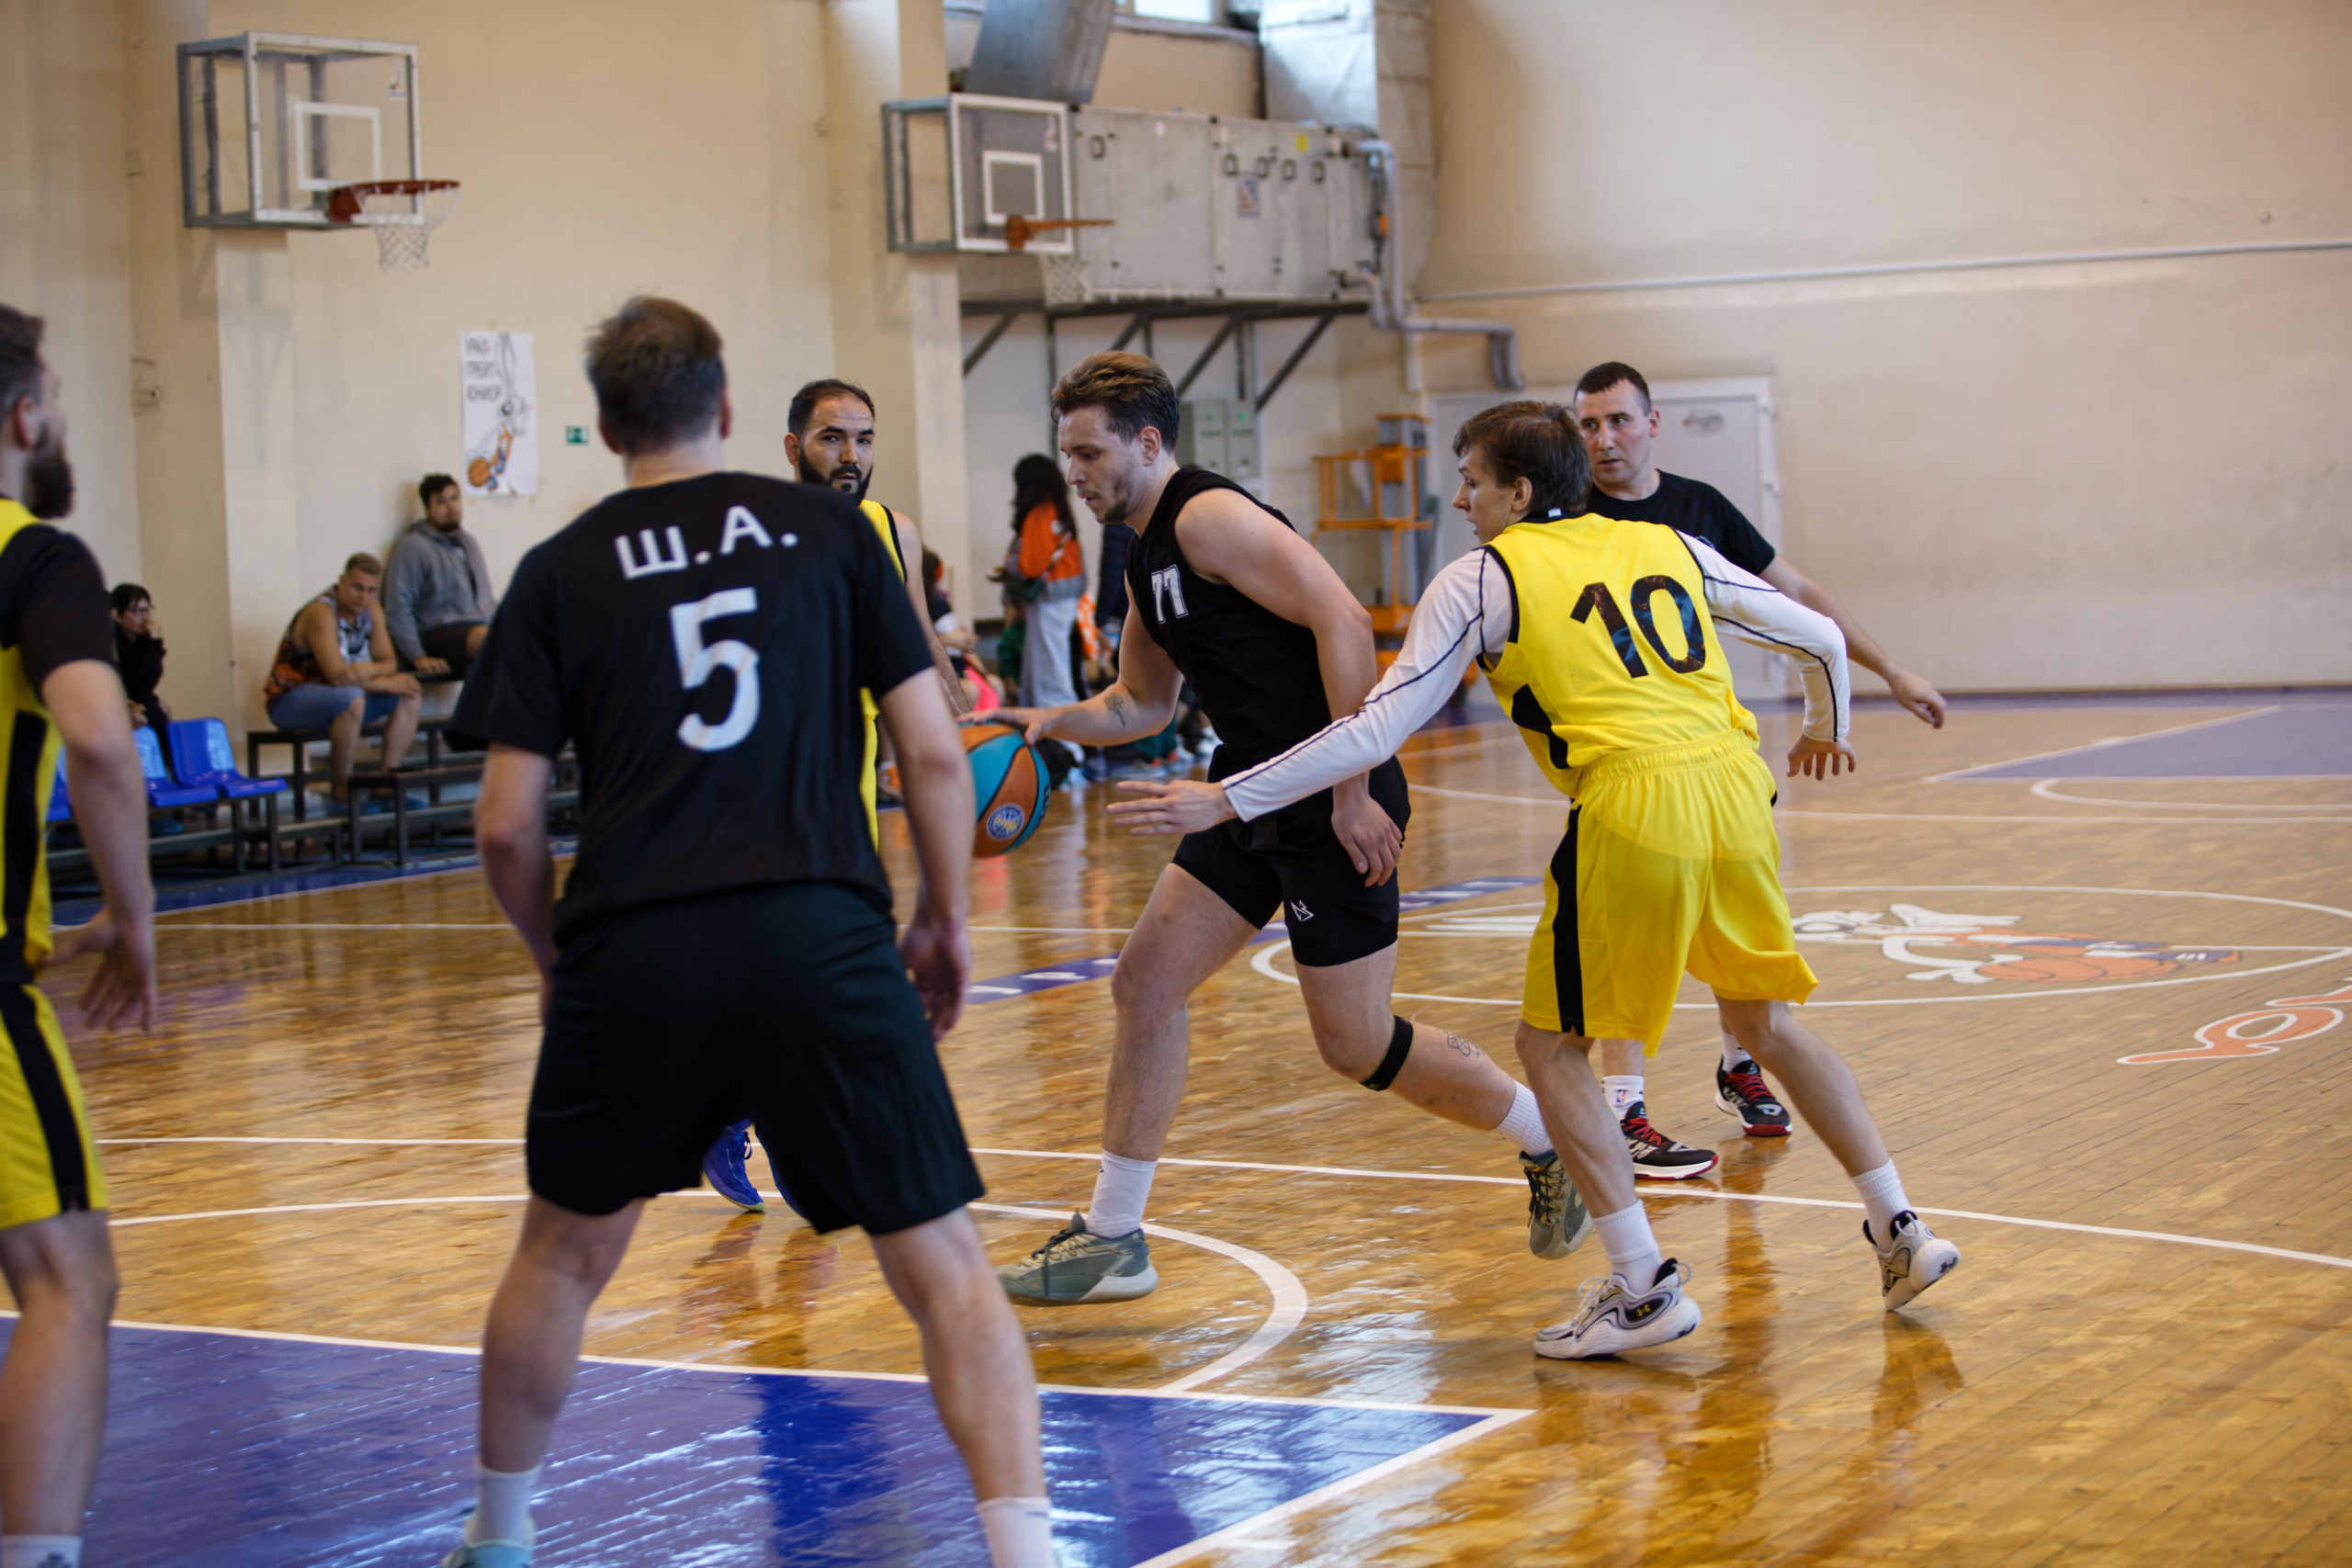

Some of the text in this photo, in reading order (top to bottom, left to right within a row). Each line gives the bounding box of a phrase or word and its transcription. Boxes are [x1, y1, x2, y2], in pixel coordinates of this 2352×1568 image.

[1150, 564, 1189, 625] 77
[1570, 575, 1706, 679] 10
[670, 586, 760, 751] 5
